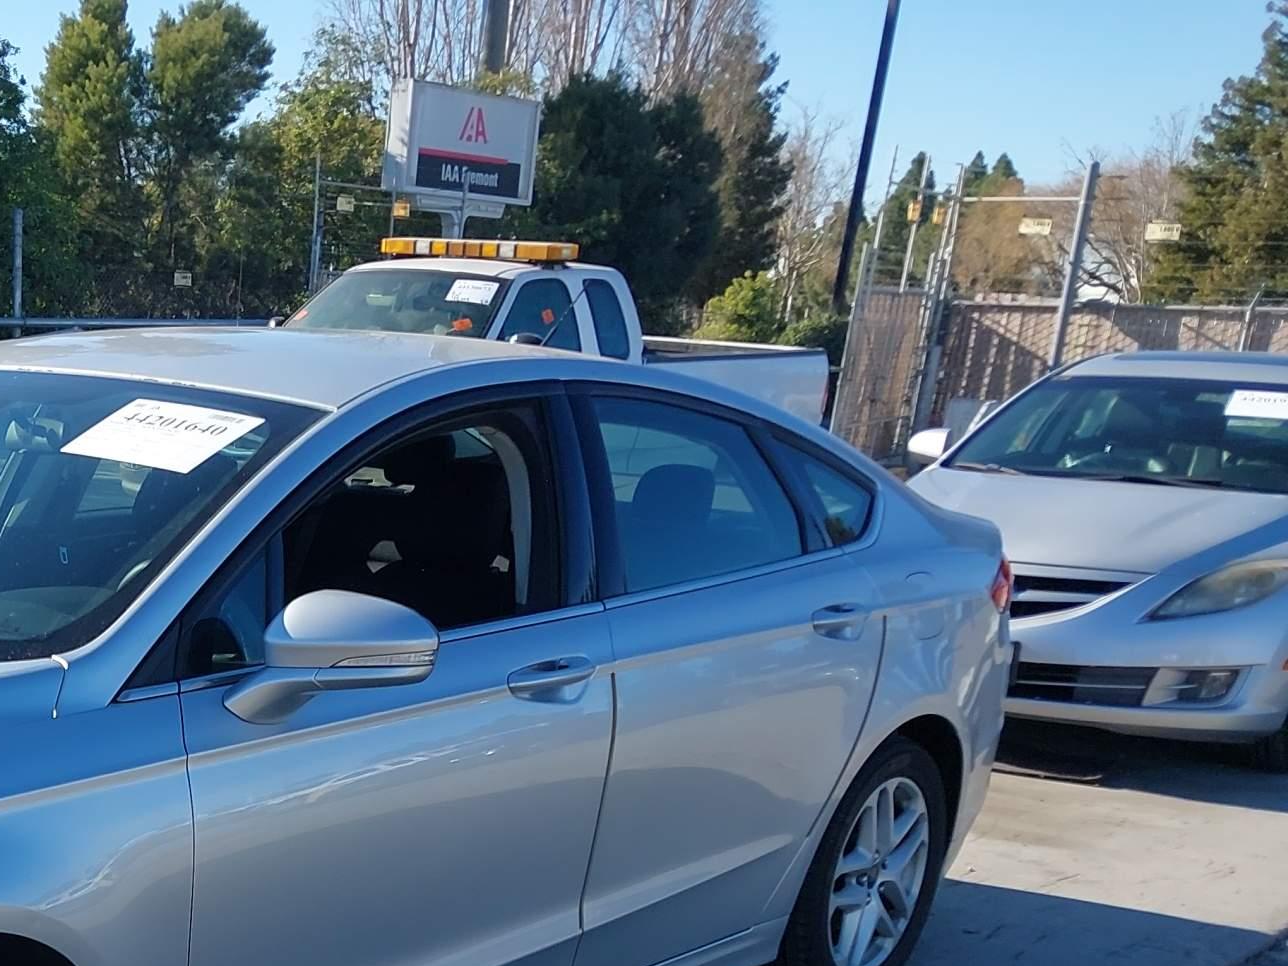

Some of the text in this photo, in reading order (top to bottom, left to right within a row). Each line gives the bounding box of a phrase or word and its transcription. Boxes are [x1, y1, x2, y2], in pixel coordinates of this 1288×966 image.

[441, 158, 499, 187] IAA Fremont
[124, 413, 228, 436] 44201640
